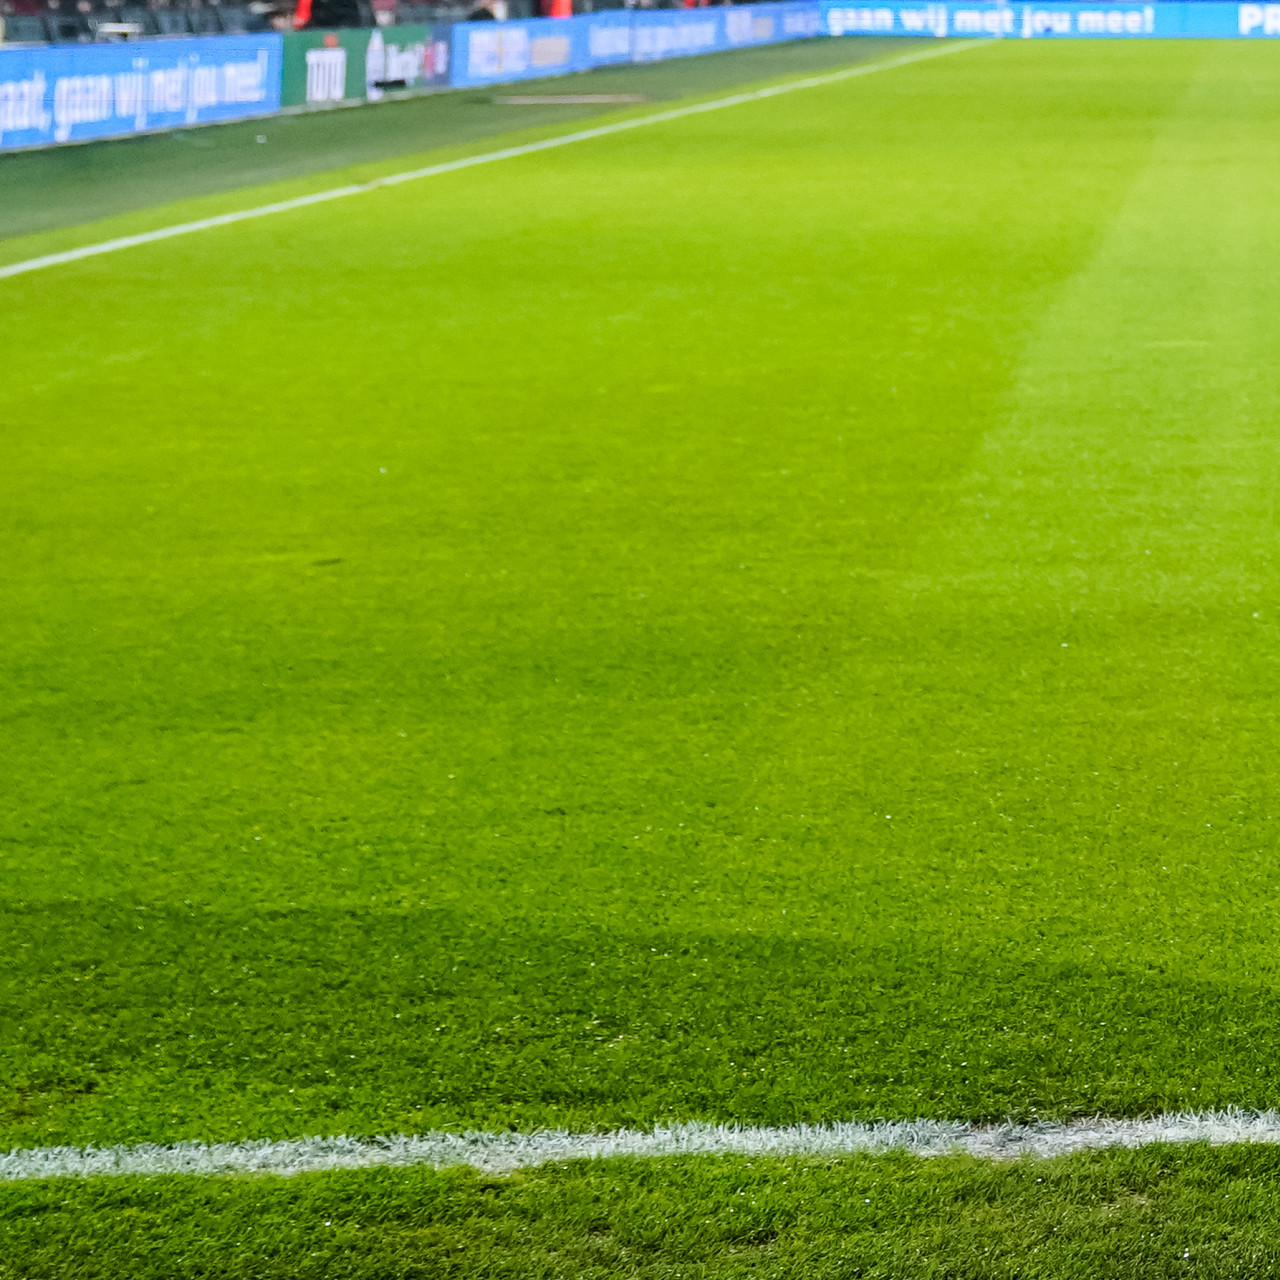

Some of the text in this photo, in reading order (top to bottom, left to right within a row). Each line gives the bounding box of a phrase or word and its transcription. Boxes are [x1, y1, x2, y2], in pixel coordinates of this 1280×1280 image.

[827, 7, 894, 37] gaan
[900, 4, 948, 38] wij
[953, 7, 1015, 33] met
[1020, 4, 1073, 39] jou
[1076, 5, 1155, 33] mee!
